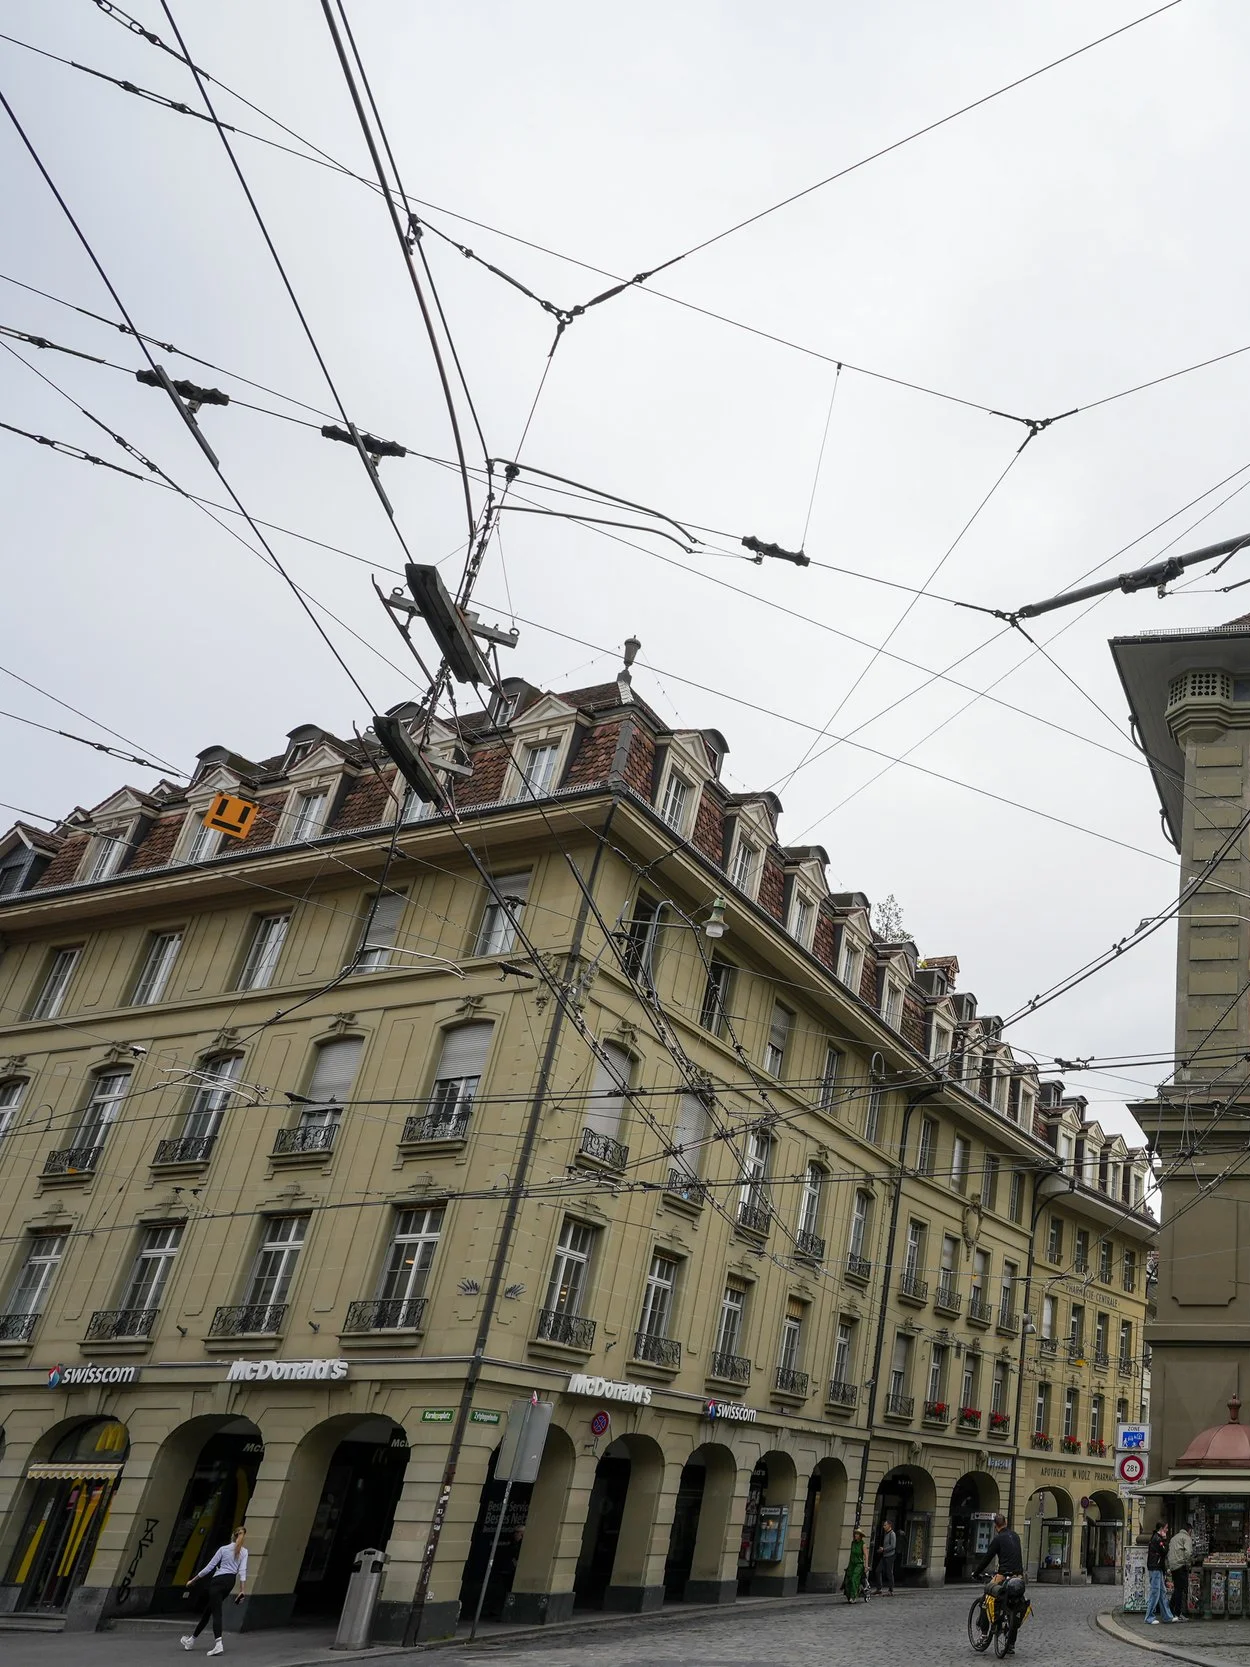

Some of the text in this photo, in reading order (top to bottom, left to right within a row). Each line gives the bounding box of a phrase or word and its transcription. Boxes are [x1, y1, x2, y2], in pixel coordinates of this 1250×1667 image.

[62, 1363, 136, 1384] swisscom
[226, 1359, 348, 1381] McDonald's
[567, 1375, 652, 1405] McDonald's
[716, 1403, 757, 1422] swisscom
[1041, 1467, 1066, 1479] APOTHEKE
